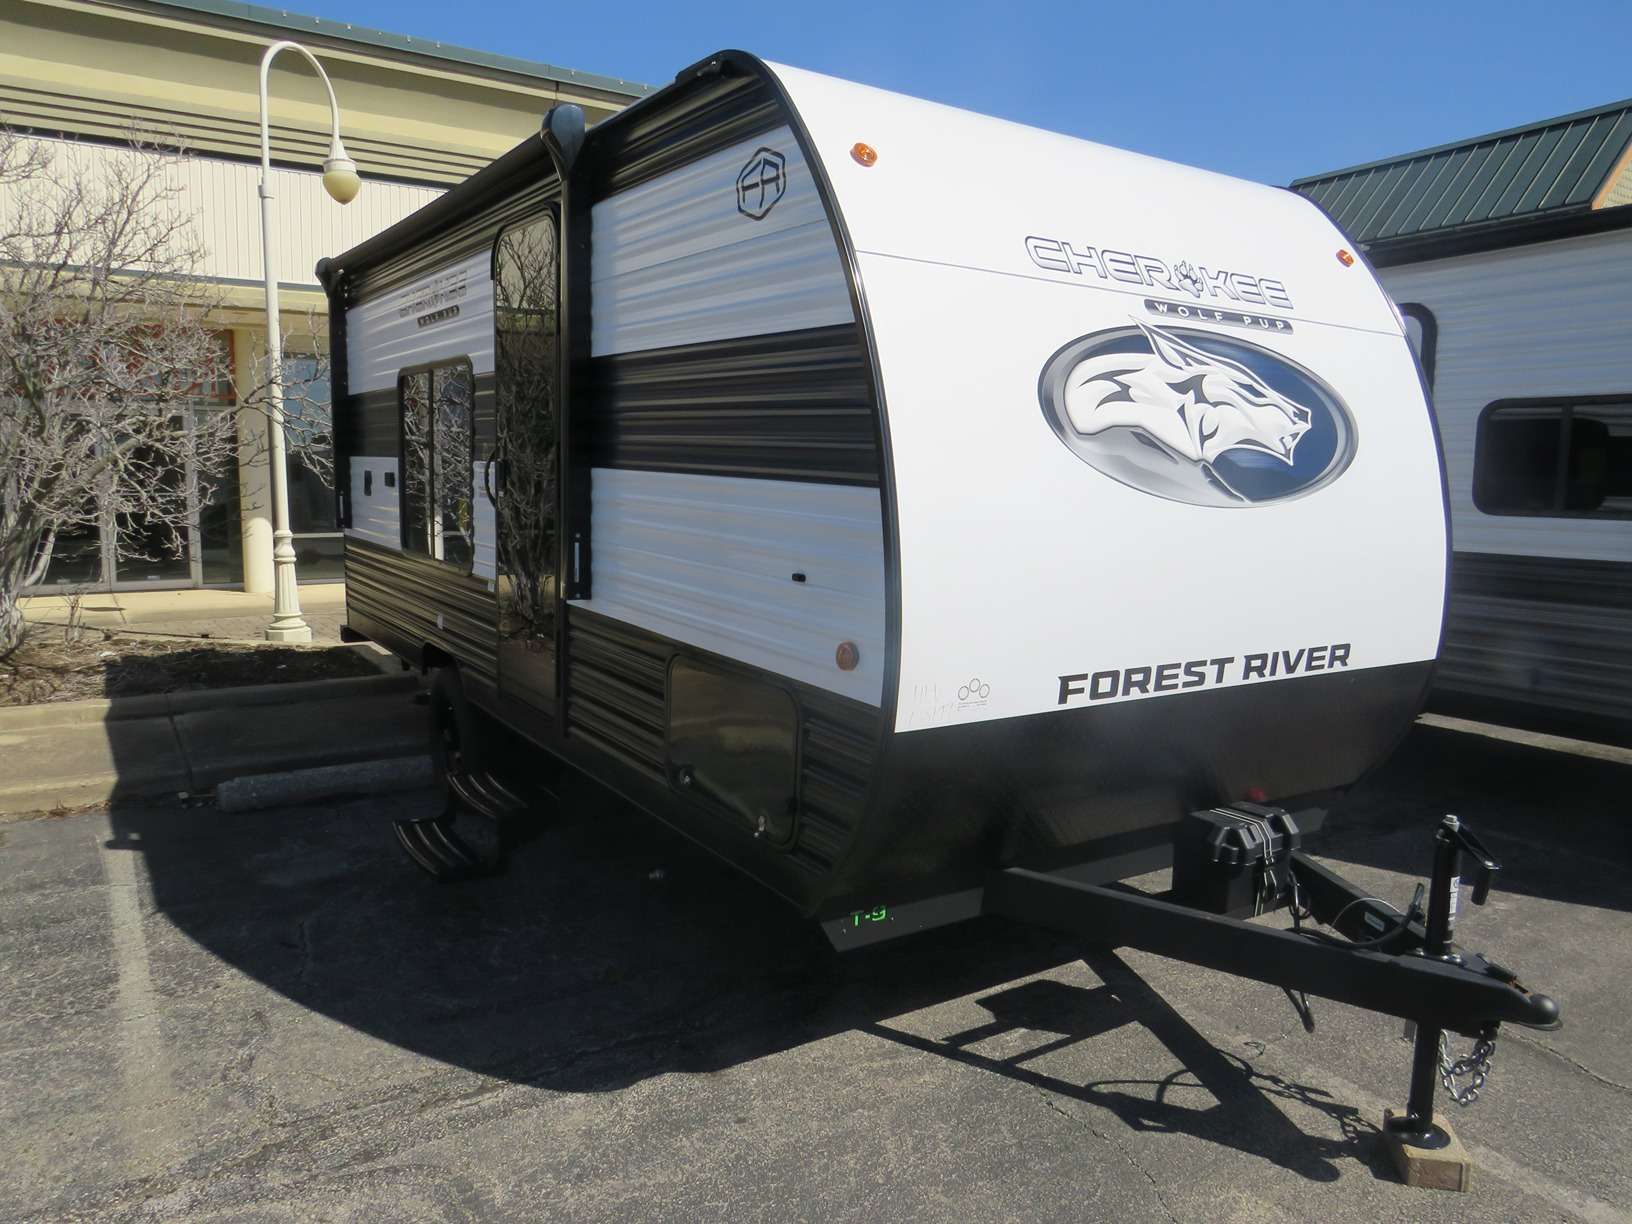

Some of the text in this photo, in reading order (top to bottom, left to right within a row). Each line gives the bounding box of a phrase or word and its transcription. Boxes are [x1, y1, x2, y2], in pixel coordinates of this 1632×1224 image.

[1154, 302, 1285, 330] WOLF PUP
[1057, 643, 1352, 705] FOREST RIVER
